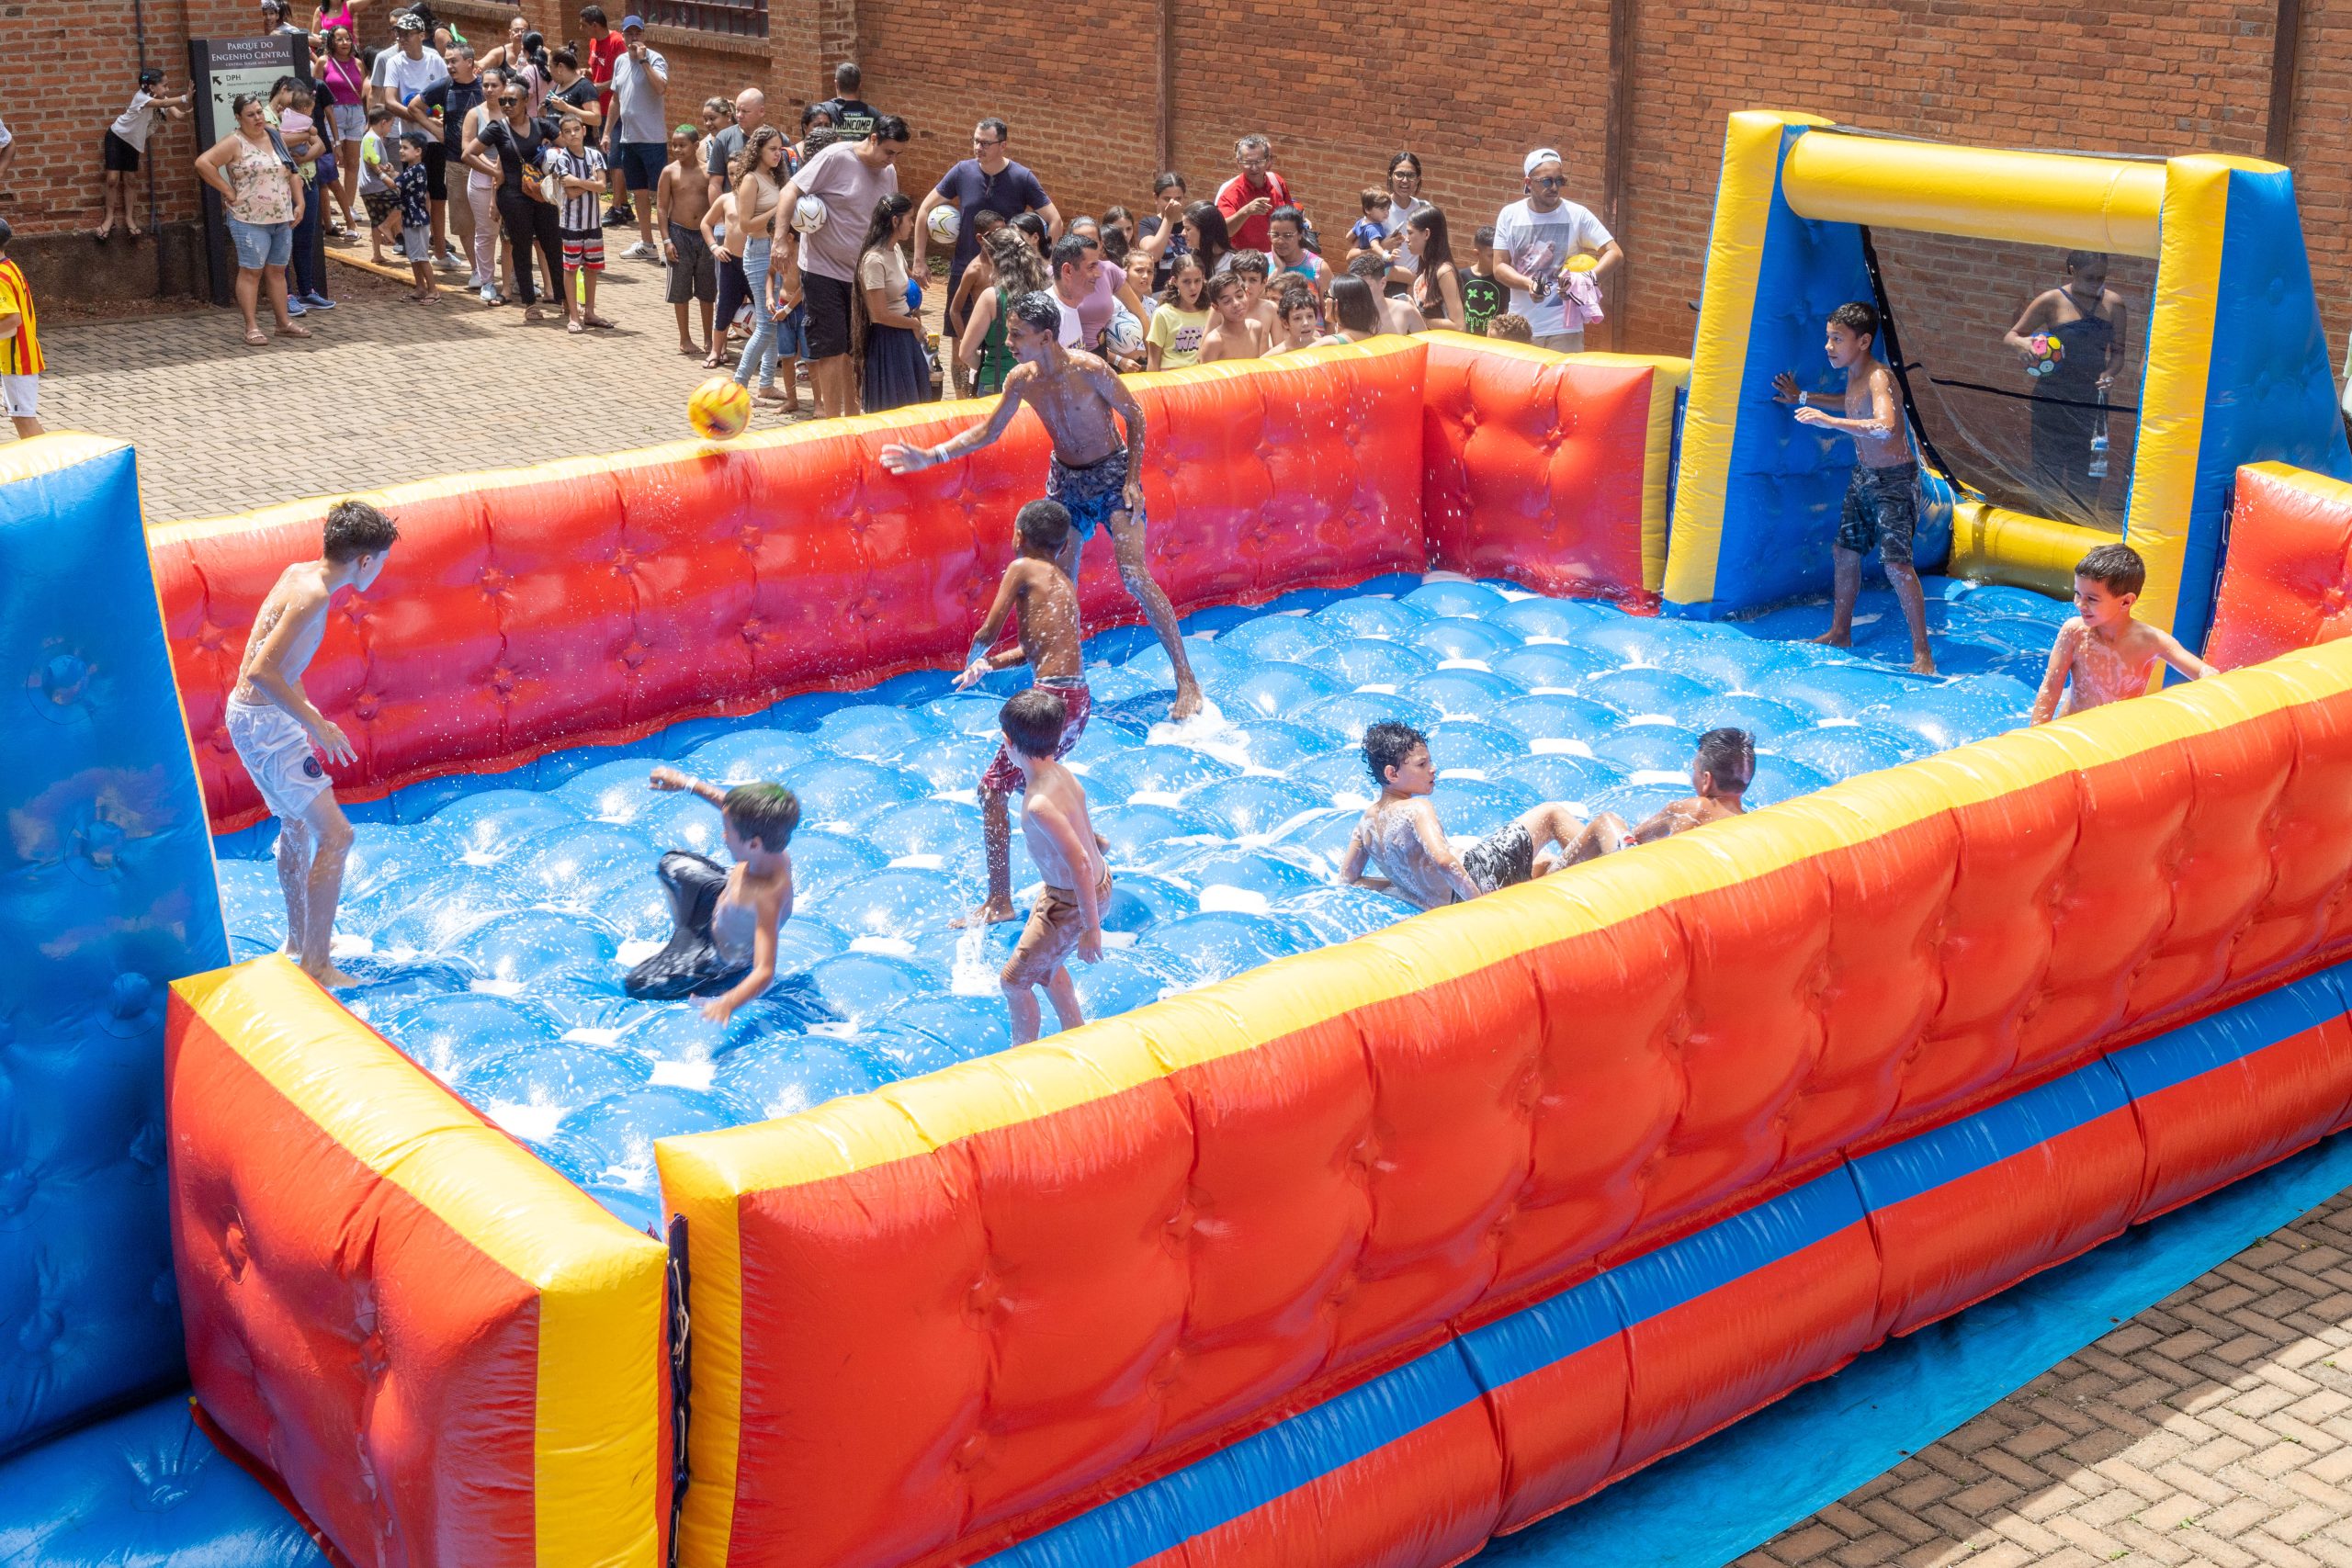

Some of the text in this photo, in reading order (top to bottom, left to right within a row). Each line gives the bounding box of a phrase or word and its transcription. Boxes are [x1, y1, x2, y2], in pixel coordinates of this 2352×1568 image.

[227, 42, 258, 51] PARQUE
[211, 51, 291, 62] ENGENHO CENTRAL
